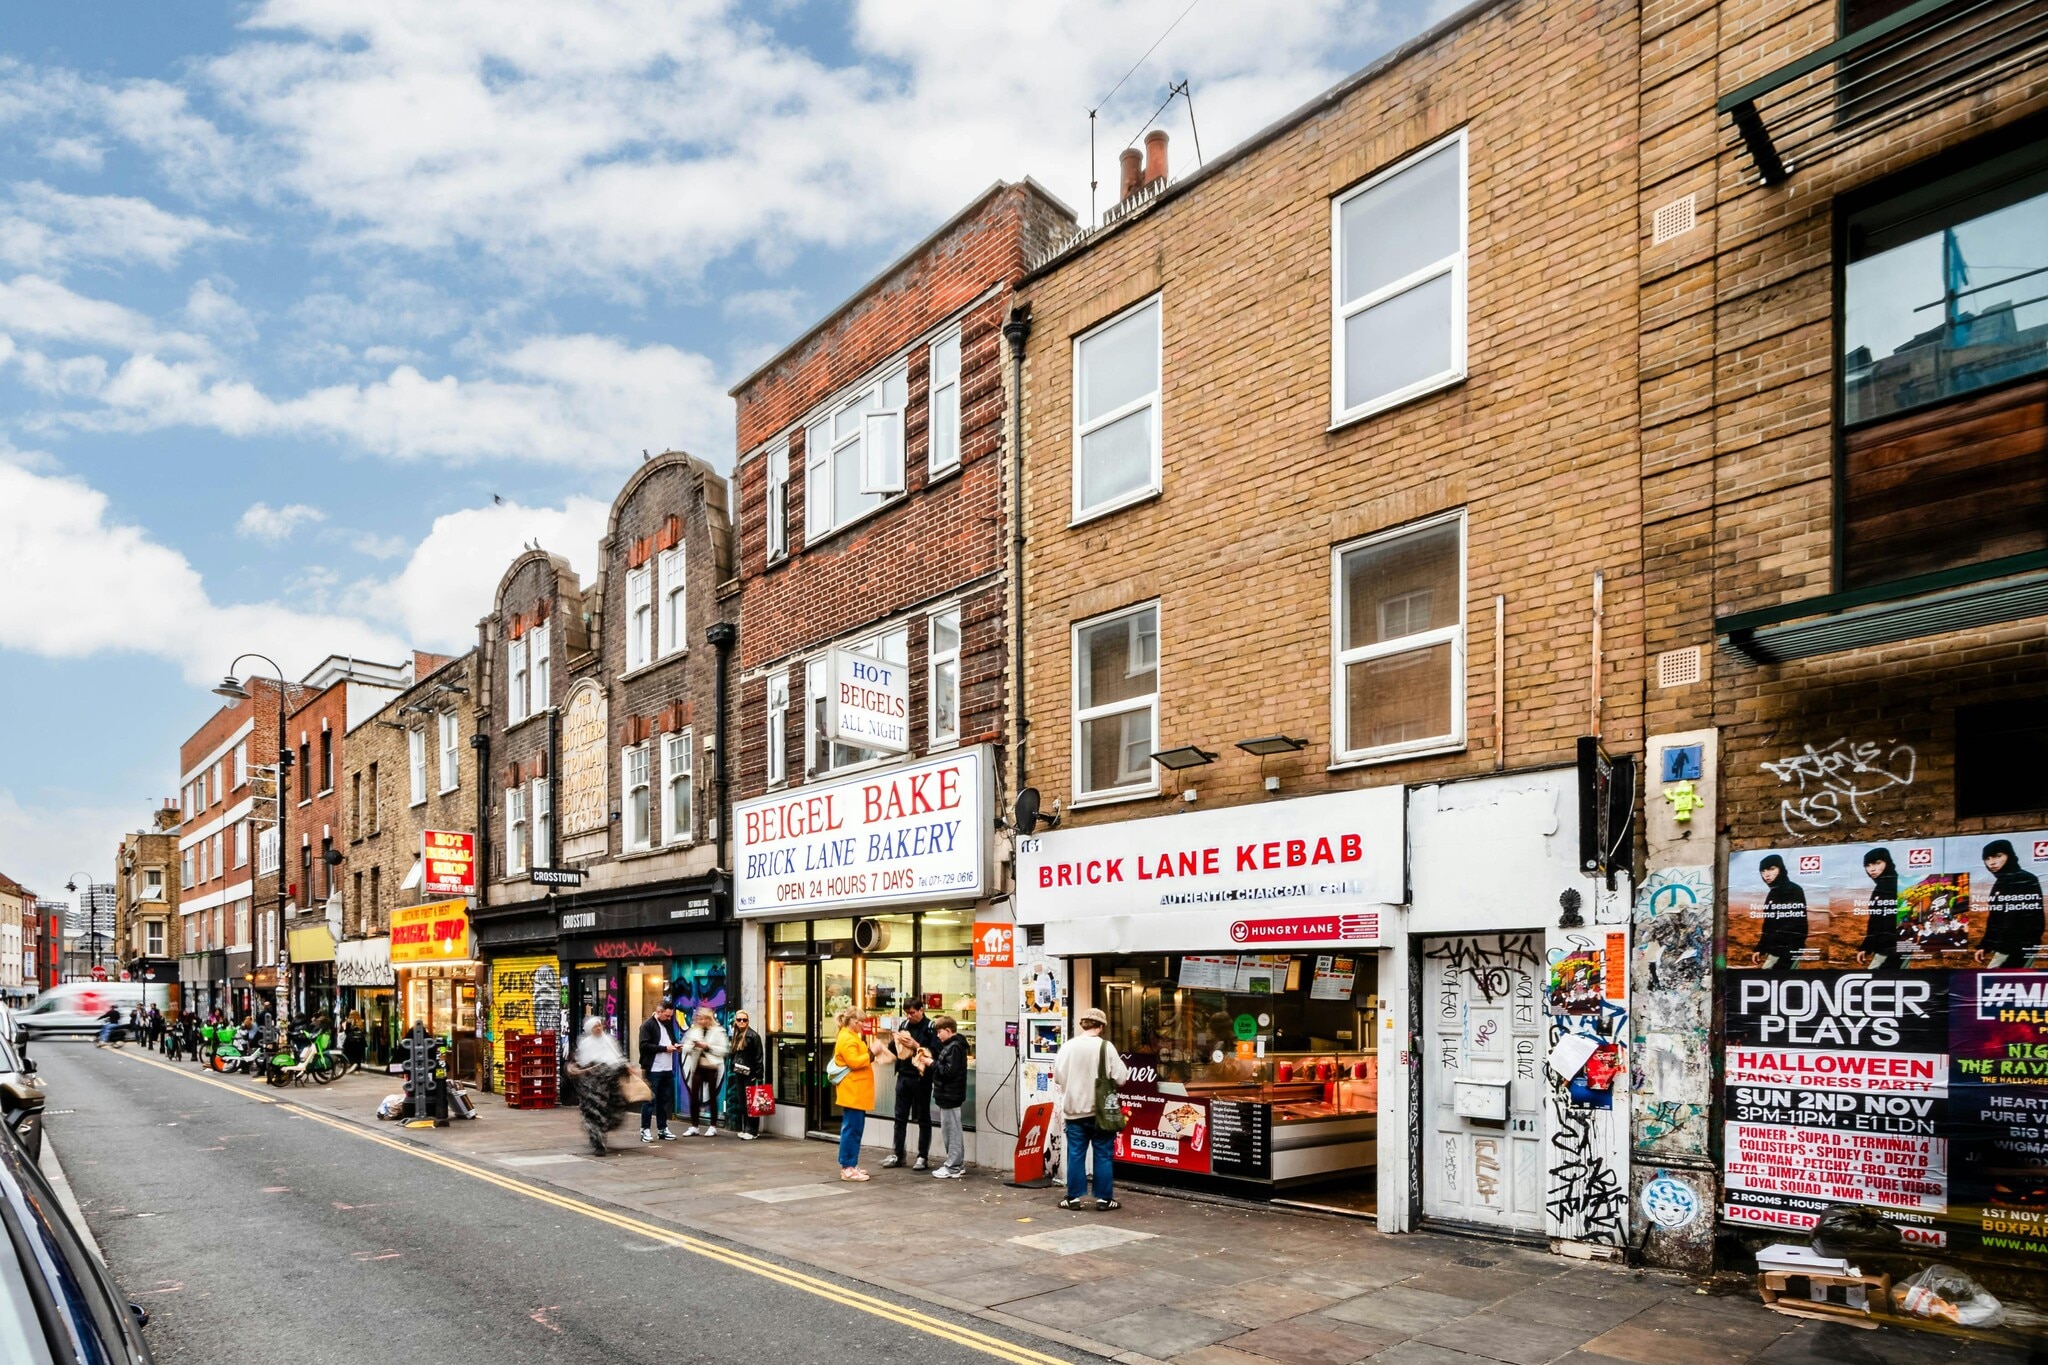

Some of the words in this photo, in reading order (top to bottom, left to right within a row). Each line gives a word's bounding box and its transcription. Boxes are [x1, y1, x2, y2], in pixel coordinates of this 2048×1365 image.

[853, 661, 892, 687] HOT
[577, 693, 591, 708] THE
[840, 682, 906, 718] BEIGELS
[568, 704, 601, 732] JOLLY
[841, 714, 864, 733] ALL
[868, 719, 904, 742] NIGHT
[563, 720, 606, 752] BUTCHERS
[564, 747, 607, 776] TRUMAN
[564, 767, 606, 796] HANBURY
[564, 787, 606, 815] BUXTON
[745, 794, 844, 846] BEIGEL
[862, 767, 962, 824] BAKE
[434, 833, 463, 847] HOT
[746, 847, 797, 880] BRICK
[805, 838, 857, 871] LANE
[866, 820, 961, 863] BAKERY
[433, 862, 467, 875] SHOP
[1039, 858, 1124, 888] BRICK
[1138, 847, 1220, 880] LANE
[1236, 833, 1363, 872] KEBAB
[533, 871, 579, 884] CROSSTOWN
[777, 881, 805, 901] OPEN
[810, 880, 822, 898] 24
[827, 874, 866, 896] HOURS
[871, 873, 878, 891] 7
[883, 868, 914, 890] DAYS
[957, 871, 974, 883] 0616
[1160, 889, 1233, 906] AUTHENTIC
[1236, 884, 1311, 901] CHARCOAL
[1854, 899, 1876, 907] New
[1971, 894, 1996, 903] New
[1997, 892, 2042, 902] season.
[1750, 902, 1770, 910] New
[1771, 902, 1807, 910] season.
[1750, 911, 1775, 919] Same
[1775, 910, 1807, 919] jacket.
[1853, 907, 1882, 915] Same
[1882, 907, 1897, 916] jac
[1971, 904, 2002, 912] Same
[2004, 902, 2042, 913] jacket.
[433, 919, 465, 940] SHOP
[563, 912, 596, 929] CROSSTOWN
[1251, 925, 1299, 935] HUNGRY
[1303, 923, 1333, 934] LANE
[978, 954, 996, 962] JUST
[996, 954, 1009, 962] EAT
[1740, 973, 1931, 1021] PIONEER
[1760, 1016, 1900, 1047] PLAYS
[1127, 1065, 1157, 1083] ner
[1738, 1052, 1934, 1079] HALLOWEEN
[1957, 1059, 1995, 1074] THE
[1738, 1072, 1793, 1084] FANCY
[1800, 1075, 1862, 1089] DRESS
[1867, 1079, 1933, 1092] PARTY
[1736, 1087, 1792, 1108] SUN
[1798, 1091, 1857, 1112] 2ND
[1865, 1096, 1934, 1117] NOV
[1737, 1106, 1836, 1127] 3PM-11PM
[1856, 1114, 1878, 1130] E1
[1885, 1117, 1935, 1135] LDN
[1980, 1110, 2027, 1122] PURE
[1133, 1127, 1151, 1137] Wrap
[1739, 1126, 1787, 1141] PIONEER
[1797, 1130, 1830, 1145] SUPA
[1832, 1134, 1841, 1146] D
[1852, 1136, 1918, 1153] TERMINAL
[1920, 1142, 1930, 1154] 4
[2010, 1126, 2039, 1138] BIG
[1018, 1148, 1030, 1158] JUST
[1030, 1146, 1041, 1155] EAT
[1133, 1139, 1165, 1150] £6.99
[1739, 1139, 1806, 1155] COLDSTEPS
[1816, 1146, 1861, 1161] SPIDEY
[1864, 1149, 1873, 1162] G
[1884, 1152, 1917, 1166] DEZY
[1919, 1155, 1929, 1167] B
[1131, 1152, 1146, 1160] From
[1741, 1151, 1793, 1167] WIGMAN
[1803, 1158, 1850, 1172] PETCHY
[1861, 1163, 1886, 1176] FRO
[1897, 1167, 1926, 1180] CKP
[1745, 1175, 1778, 1190] LOYAL
[1780, 1180, 1821, 1195] SQUAD
[1832, 1185, 1864, 1200] NWR
[1878, 1191, 1921, 1207] MORE!
[1768, 1166, 1806, 1181] DIMPZ
[1808, 1171, 1815, 1181] &
[1819, 1172, 1854, 1186] LAWZ
[1865, 1177, 1900, 1193] PURE
[1902, 1181, 1943, 1196] VIBES
[1732, 1192, 1740, 1200] 2
[1741, 1193, 1782, 1206] ROOMS
[1729, 1207, 1819, 1228] PIONEER
[1982, 1208, 2006, 1218] 1ST
[2010, 1211, 2040, 1222] NOV
